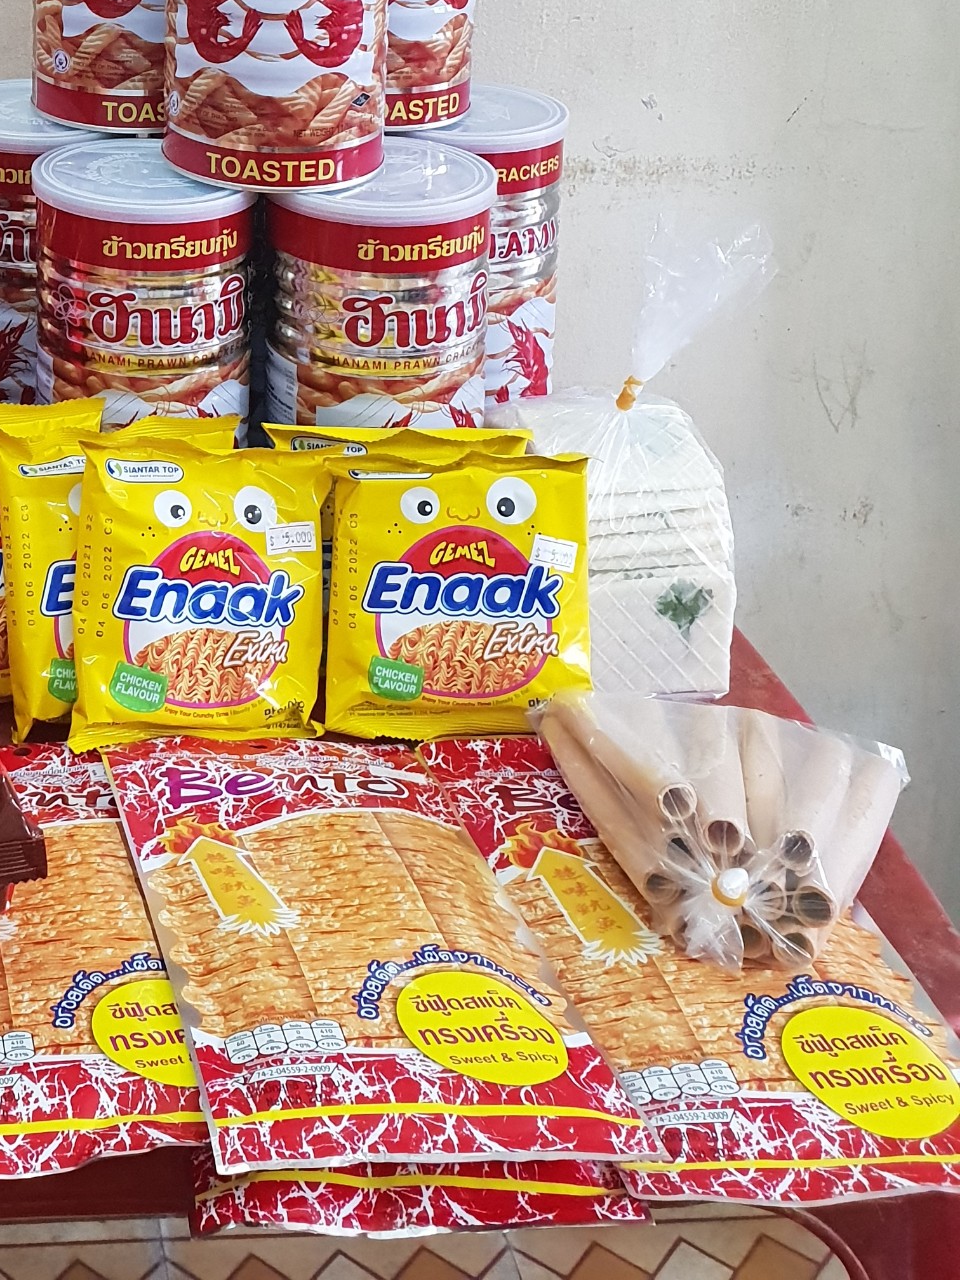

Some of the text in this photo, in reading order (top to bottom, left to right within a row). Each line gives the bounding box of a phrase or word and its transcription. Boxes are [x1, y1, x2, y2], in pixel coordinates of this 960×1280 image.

[206, 151, 336, 182] TOASTED
[498, 155, 559, 183] RACKERS
[102, 228, 238, 261] ข้าวเกรียบกุ้ง
[357, 224, 485, 262] ข้าวเกรียบกุ้ง
[89, 275, 245, 347] ฮานามิ
[342, 270, 488, 348] ฮานามิ
[137, 356, 187, 369] PRAWN
[332, 355, 440, 370] HANAMI PRAWN
[123, 466, 180, 474] SIANTAR TOP
[22, 532, 33, 569] 2022
[83, 544, 93, 579] 2021
[179, 546, 242, 576] GEMEZ
[349, 538, 358, 574] 2022
[429, 541, 496, 568] GEMEZ
[103, 546, 113, 582] 2022
[26, 581, 34, 598] 06
[81, 590, 90, 607] 06
[101, 592, 110, 610] 06
[115, 568, 303, 625] Enaak
[349, 585, 358, 601] 06
[364, 563, 562, 616] Enaak
[27, 609, 36, 627] 04
[96, 620, 107, 638] 04
[349, 613, 357, 629] 04
[224, 629, 290, 668] Extra
[483, 621, 560, 661] Extra
[56, 667, 77, 678] CHIC
[120, 671, 163, 693] CHICKEN
[375, 665, 418, 684] CHICKEN
[53, 679, 76, 690] FLAV
[115, 682, 160, 704] FLAVOUR
[373, 676, 417, 695] FLAVOUR
[164, 706, 179, 717] Enjoy
[192, 711, 215, 719] Crunchy
[161, 766, 407, 809] Bento
[107, 1001, 179, 1022] ซีฟู้ดส
[109, 1028, 186, 1052] ทรงเค
[418, 1011, 556, 1047] ทรงเครื่อง
[134, 1054, 185, 1069] Sweet
[449, 1050, 559, 1066] Sweet & Spicy
[256, 1065, 331, 1079] 74-2-04559-2-0009
[808, 1050, 947, 1090] ทรงเครื่อง
[844, 1091, 955, 1116] Sweet & Spicy
